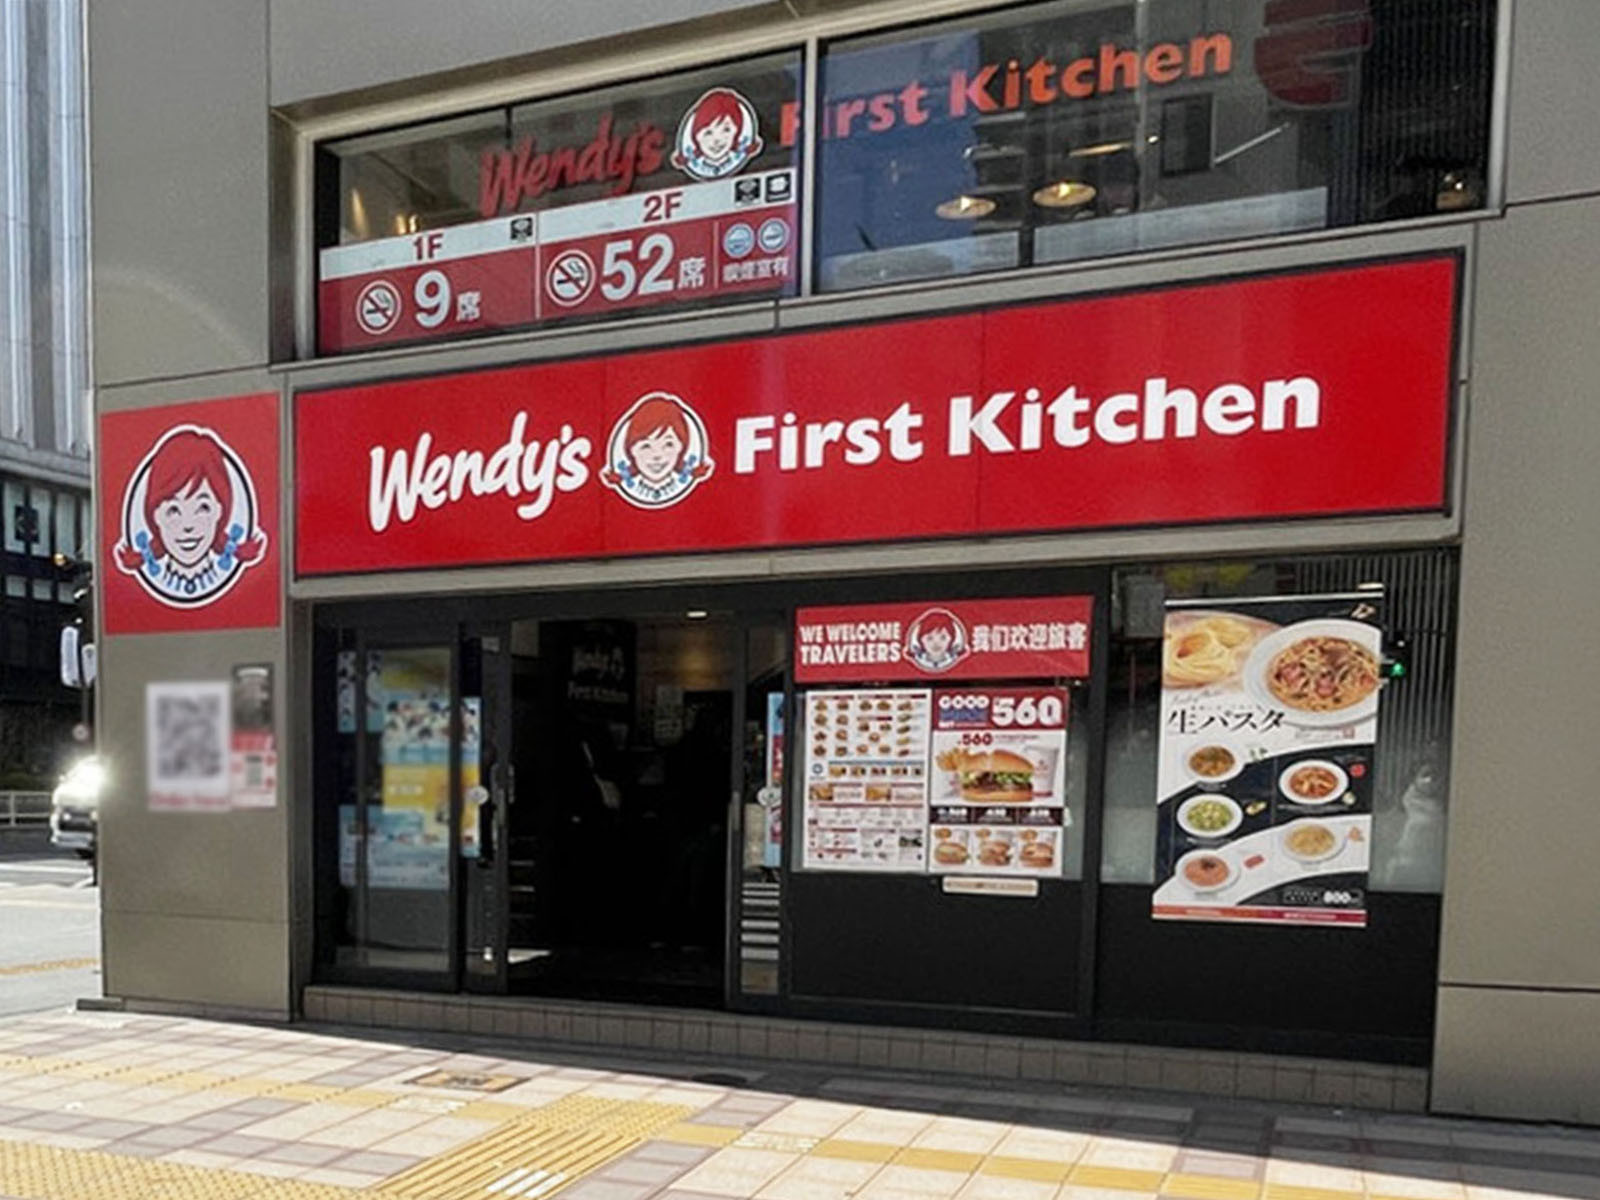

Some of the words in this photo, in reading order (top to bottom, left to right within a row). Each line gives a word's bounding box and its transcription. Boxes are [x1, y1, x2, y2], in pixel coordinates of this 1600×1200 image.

[479, 112, 664, 218] Wendy's
[949, 32, 1232, 117] Kitchen
[643, 192, 684, 223] 2F
[412, 234, 444, 261] 1F
[369, 411, 593, 532] Wendy's
[734, 402, 925, 475] First
[948, 376, 1321, 457] Kitchen
[800, 625, 823, 643] WE
[826, 622, 901, 642] WELCOME
[800, 642, 901, 665] TRAVELERS
[1167, 707, 1286, 735] 生パスタ
